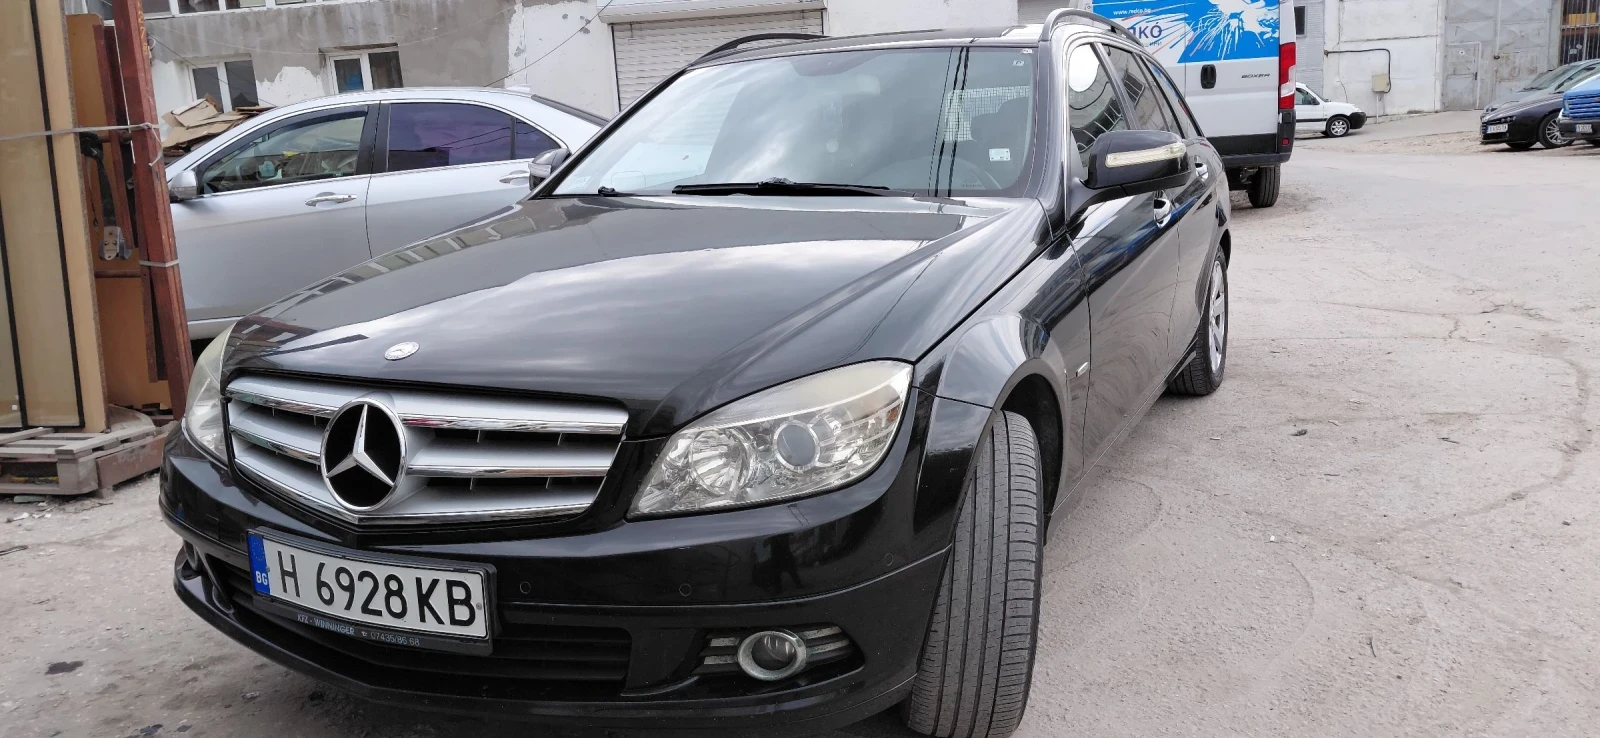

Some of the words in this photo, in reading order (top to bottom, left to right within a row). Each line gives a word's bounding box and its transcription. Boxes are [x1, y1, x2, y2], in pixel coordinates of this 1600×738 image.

[255, 570, 268, 586] BG
[277, 550, 301, 598] H
[315, 561, 408, 620] 6928
[415, 576, 477, 627] KB
[297, 613, 309, 625] KFZ
[313, 617, 355, 636] WINNINGER
